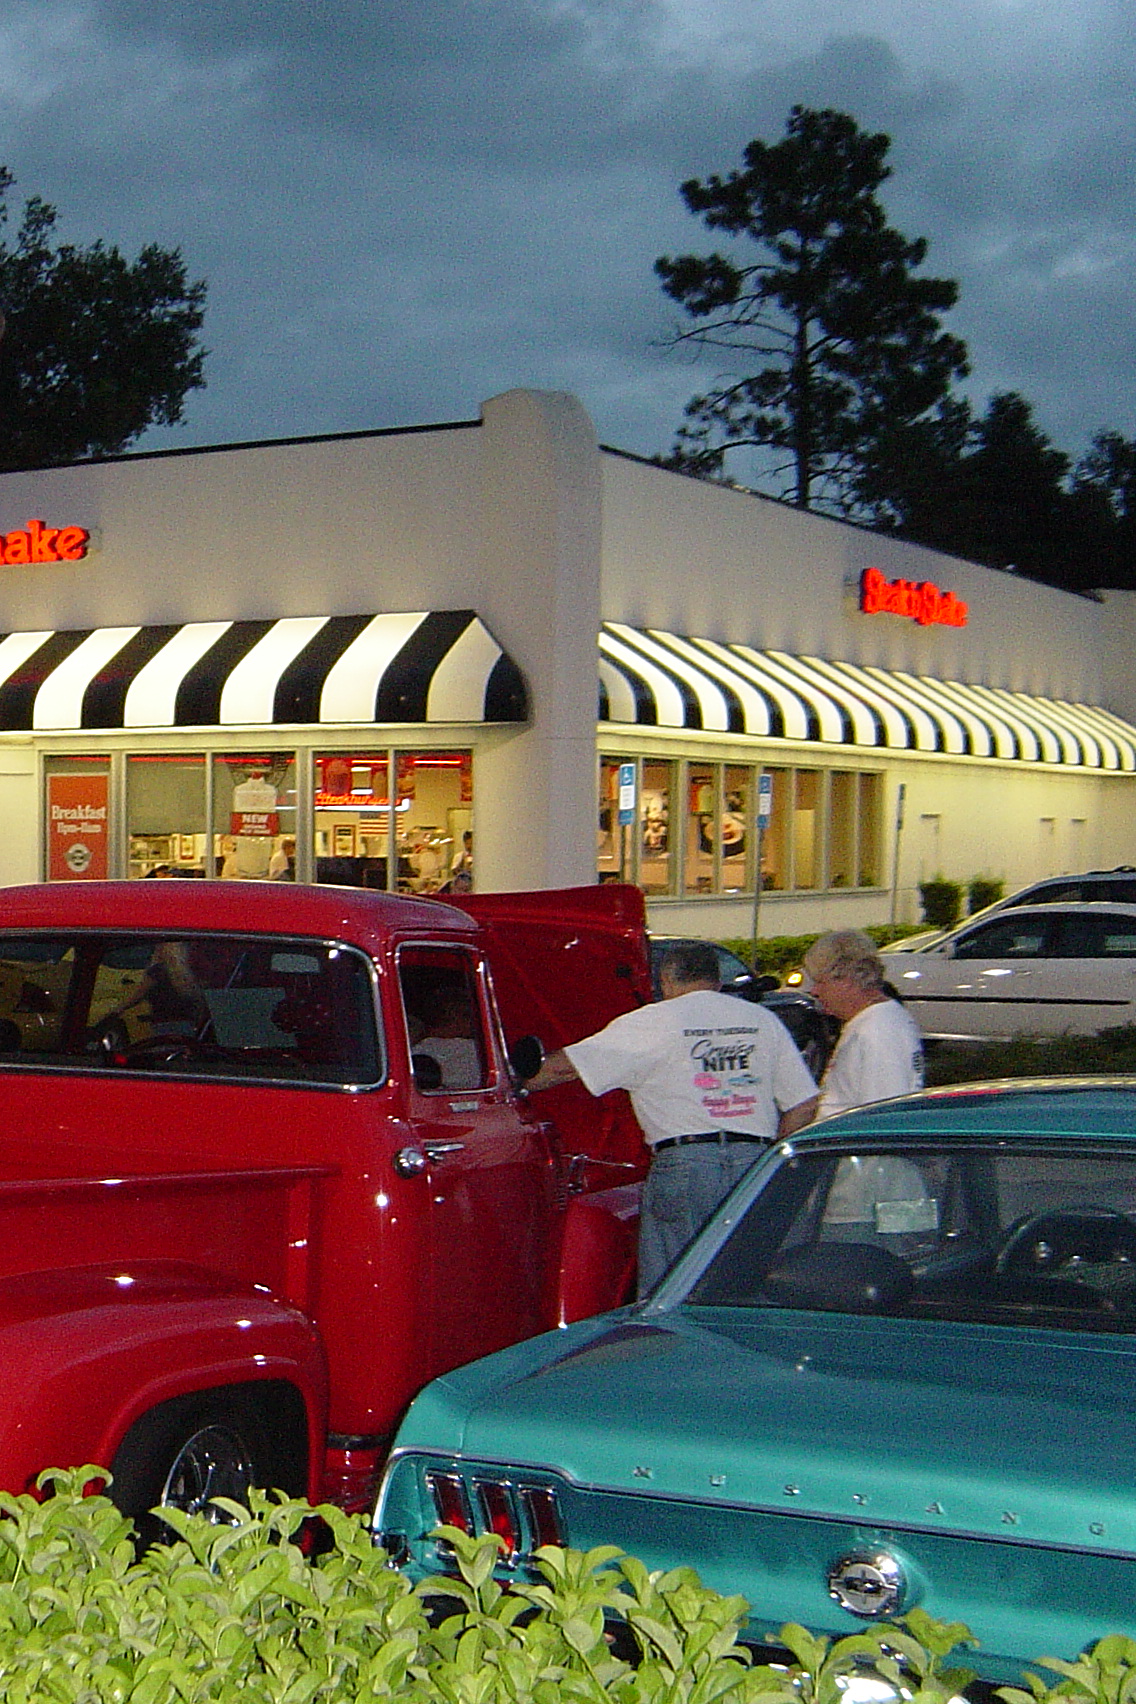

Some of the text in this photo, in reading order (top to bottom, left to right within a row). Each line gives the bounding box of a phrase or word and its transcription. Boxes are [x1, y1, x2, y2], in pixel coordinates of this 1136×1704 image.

[52, 804, 106, 820] Breakfast
[241, 813, 270, 824] NEW
[704, 1055, 750, 1072] NITE
[632, 1465, 1107, 1537] MUSTANG
